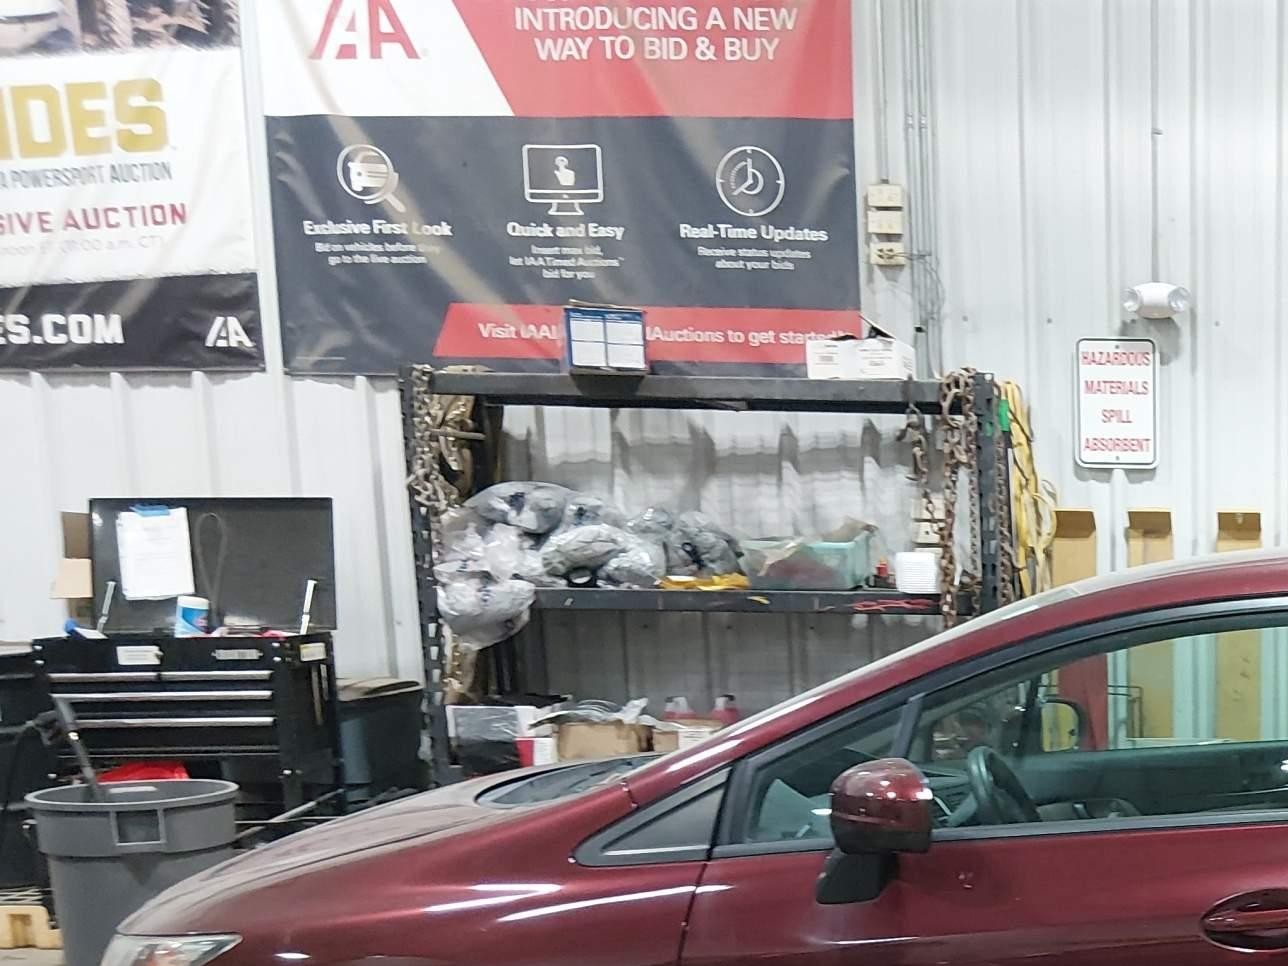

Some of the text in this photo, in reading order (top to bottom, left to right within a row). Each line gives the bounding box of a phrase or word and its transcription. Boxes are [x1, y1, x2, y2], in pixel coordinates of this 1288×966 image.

[515, 6, 797, 31] INTRODUCING A NEW
[534, 36, 779, 61] WAY TO BID & BUY
[11, 165, 104, 188] POWERSPORT
[110, 162, 172, 184] AUCTION
[64, 203, 187, 231] AUCTION
[303, 219, 453, 236] Exclusive First Look
[507, 222, 625, 241] Quick and Easy
[679, 223, 829, 242] Real-Time Updates
[478, 323, 517, 339] Visit
[728, 328, 745, 343] to
[748, 329, 775, 347] get
[1082, 351, 1150, 366] HAZARDOUS
[1084, 380, 1149, 394] MATERIALS
[1101, 409, 1132, 423] SPILL
[1084, 438, 1151, 453] ABSORBENT
